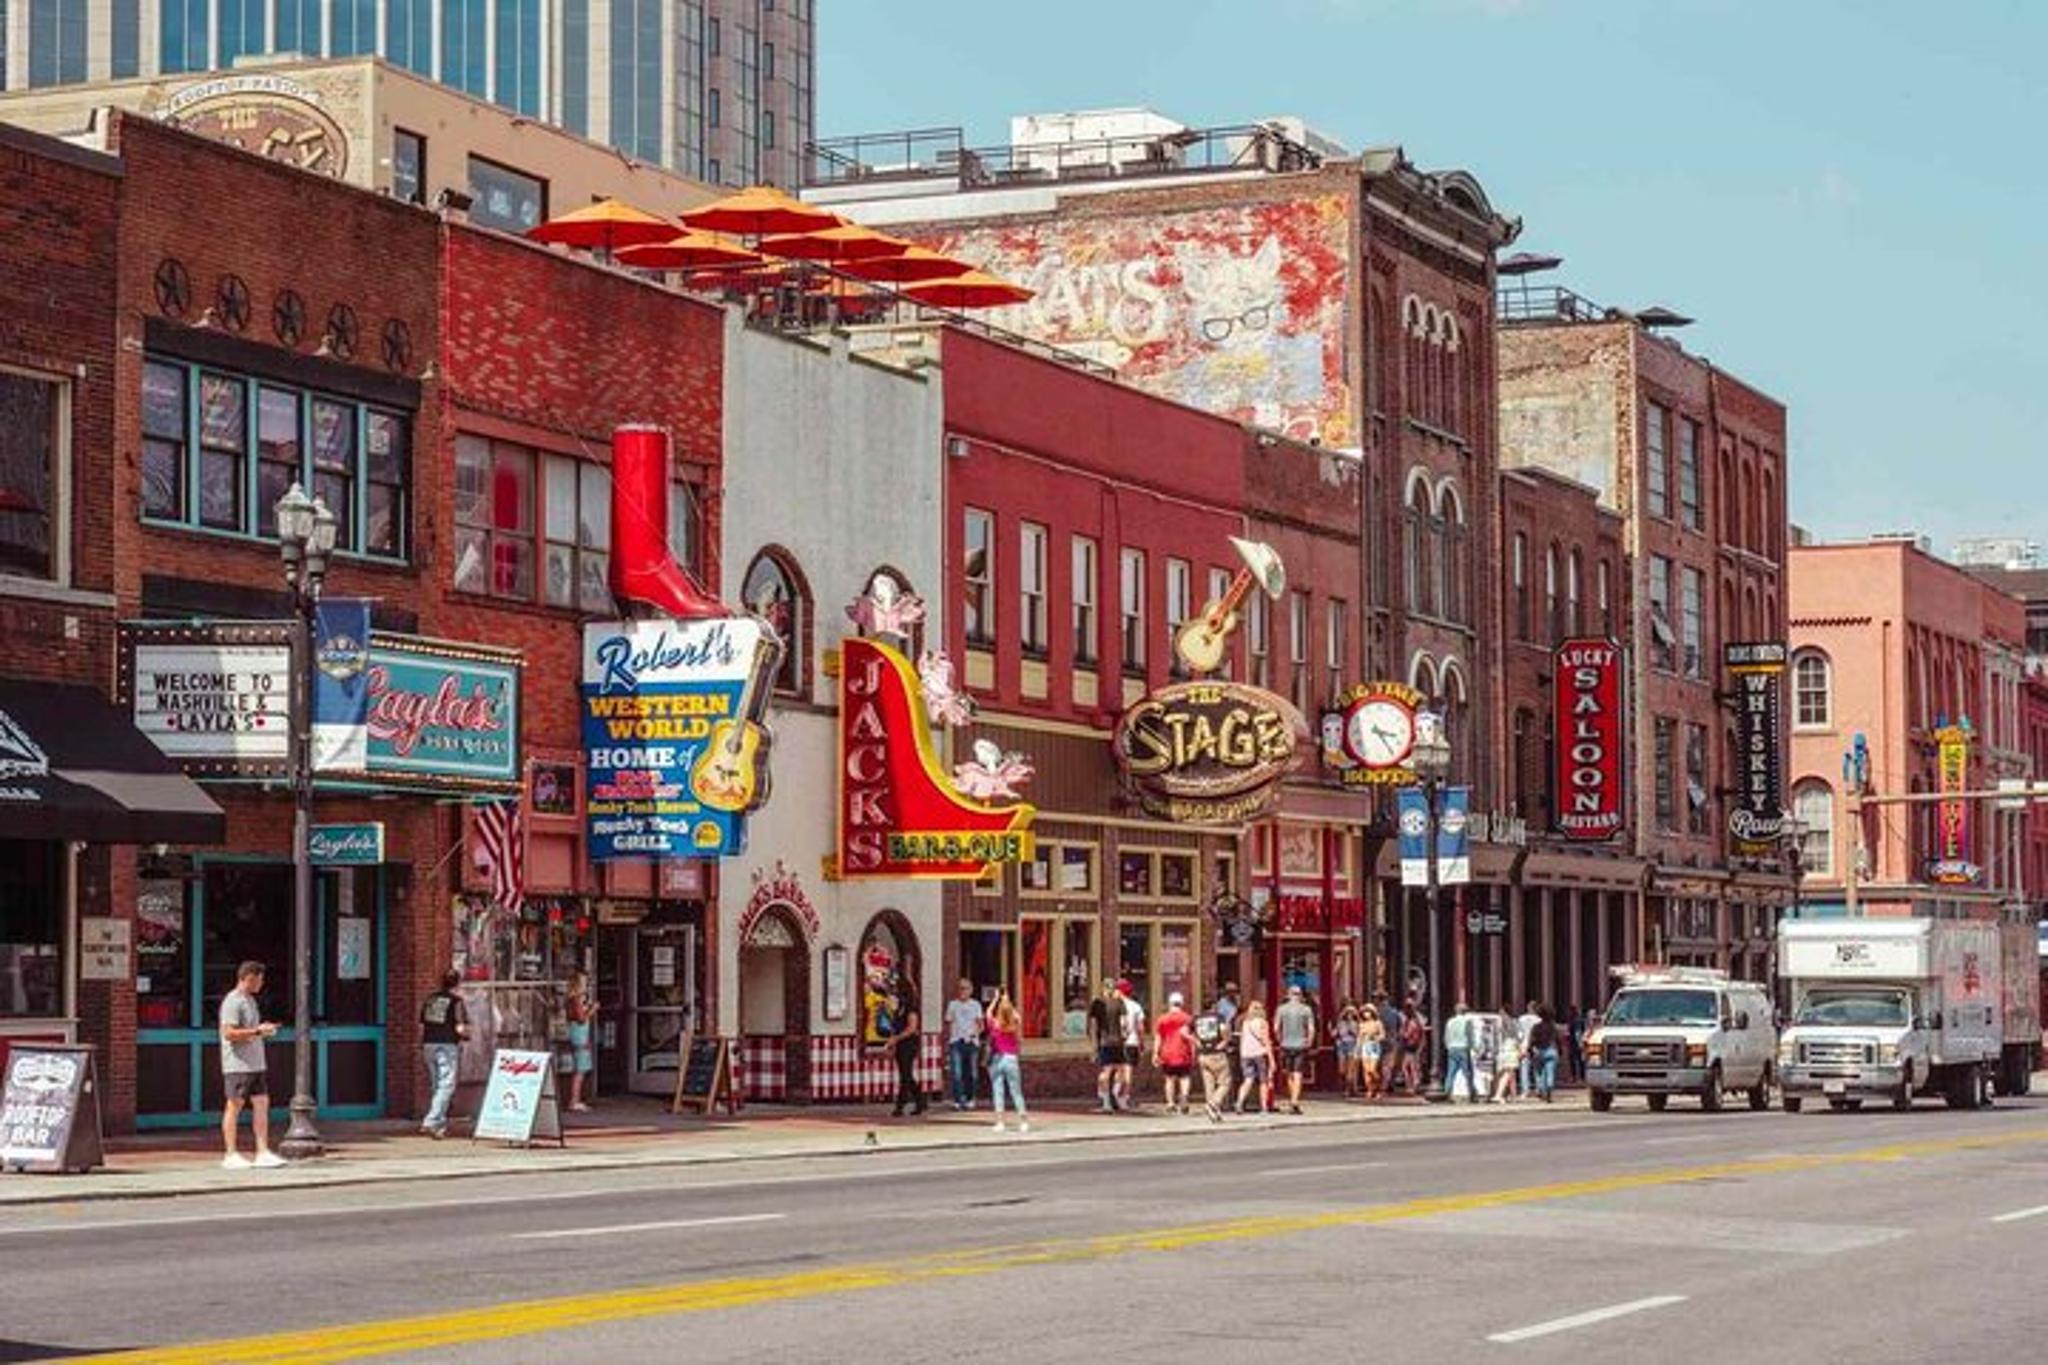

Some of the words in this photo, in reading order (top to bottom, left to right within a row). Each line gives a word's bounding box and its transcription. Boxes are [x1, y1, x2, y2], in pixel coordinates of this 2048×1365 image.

[597, 622, 735, 694] Robert's
[1561, 650, 1614, 667] LUCKY
[153, 673, 237, 692] WELCOME
[251, 673, 272, 691] TO
[1189, 686, 1224, 703] THE
[156, 693, 248, 712] NASHVILLE
[255, 692, 267, 712] &
[589, 693, 731, 718] WESTERN
[178, 712, 254, 732] LAYLA'S
[607, 717, 711, 740] WORLD
[1124, 702, 1293, 770] STAGE
[1571, 668, 1603, 812] SALOON
[1745, 675, 1768, 812] WHISKEY
[590, 747, 676, 769] HOME
[678, 744, 698, 772] of
[847, 656, 894, 869] JACKS
[612, 835, 673, 850] GRILL
